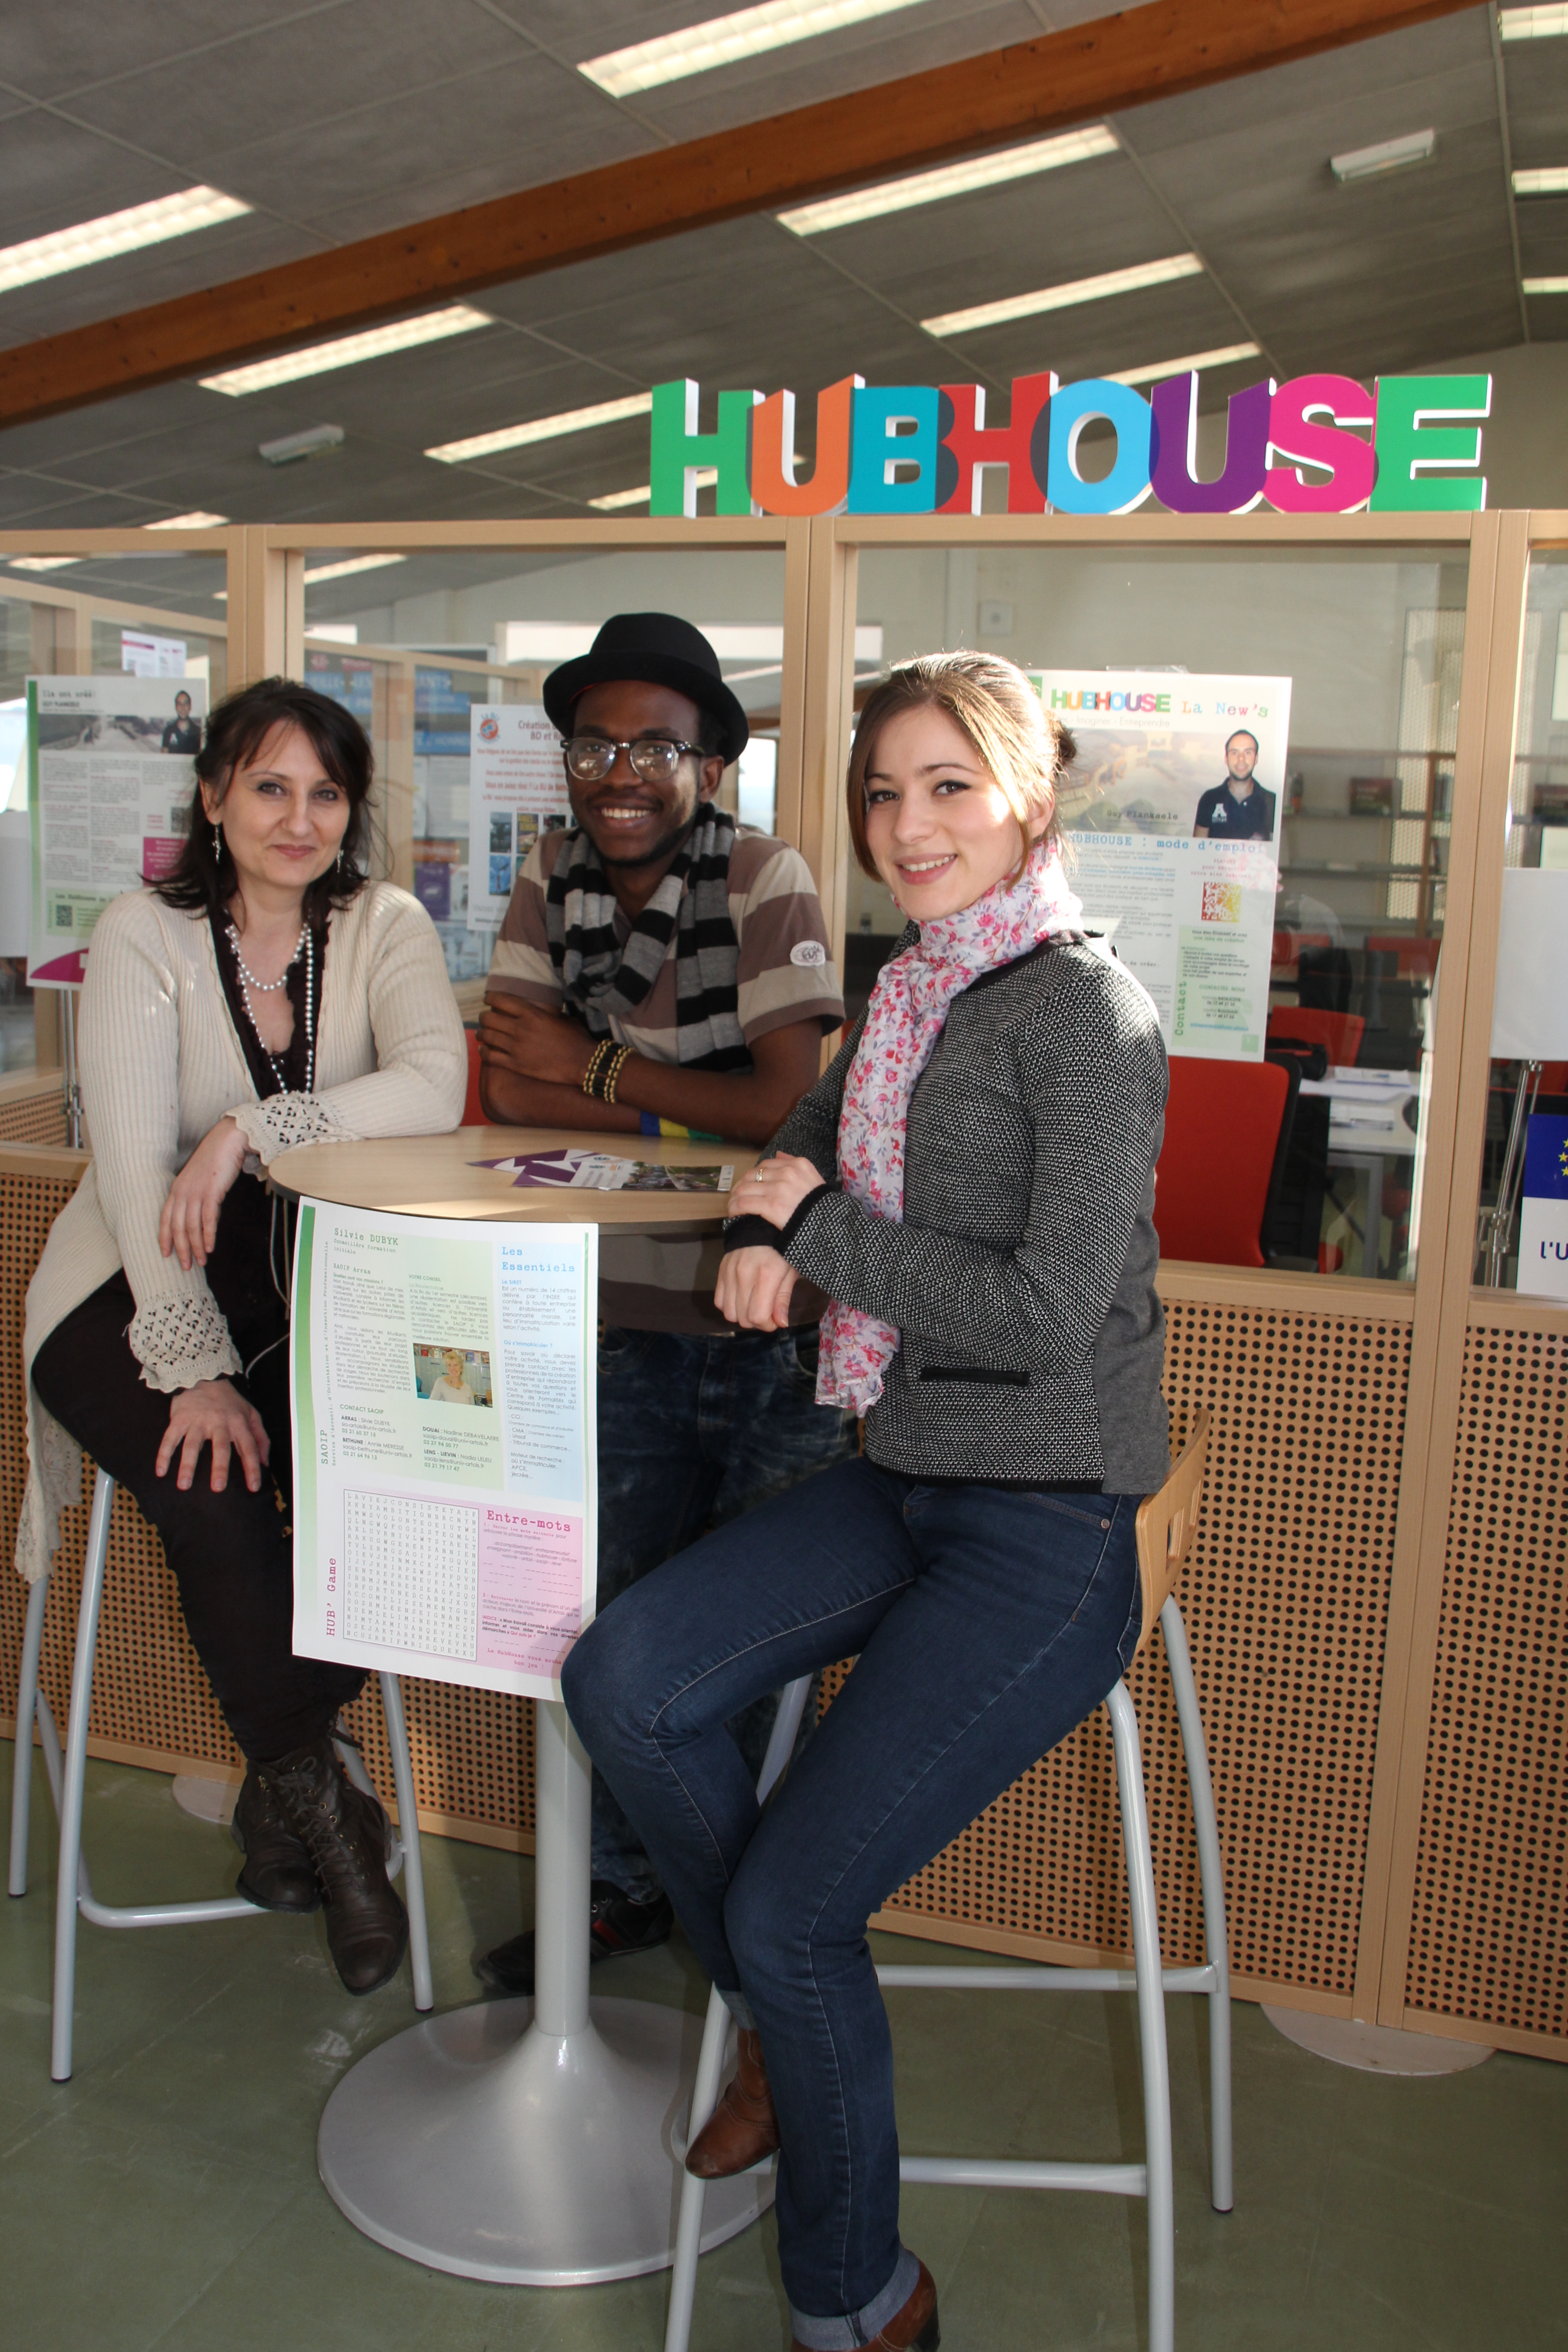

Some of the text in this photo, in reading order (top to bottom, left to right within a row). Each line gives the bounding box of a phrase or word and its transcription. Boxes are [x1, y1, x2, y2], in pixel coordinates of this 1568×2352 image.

[650, 370, 1492, 518] HUBHOUSE
[1051, 688, 1171, 713] HUBHOUSE
[1181, 701, 1269, 718] La New's
[518, 720, 550, 730] Création
[1076, 716, 1170, 728] Imaginer Entreprendre
[530, 731, 541, 740] BD
[1156, 839, 1189, 849] mode
[1198, 840, 1264, 854] d'emploi
[1175, 981, 1186, 1035] Contact
[334, 1228, 397, 1245] Silvie DUBYK
[502, 1247, 522, 1255] Les
[502, 1262, 574, 1272] Essentiels
[320, 1430, 328, 1465] SAOIP
[488, 1510, 570, 1531] Entre-mots
[326, 1558, 336, 1637] HUB' Game
[497, 1650, 524, 1658] HubHouse
